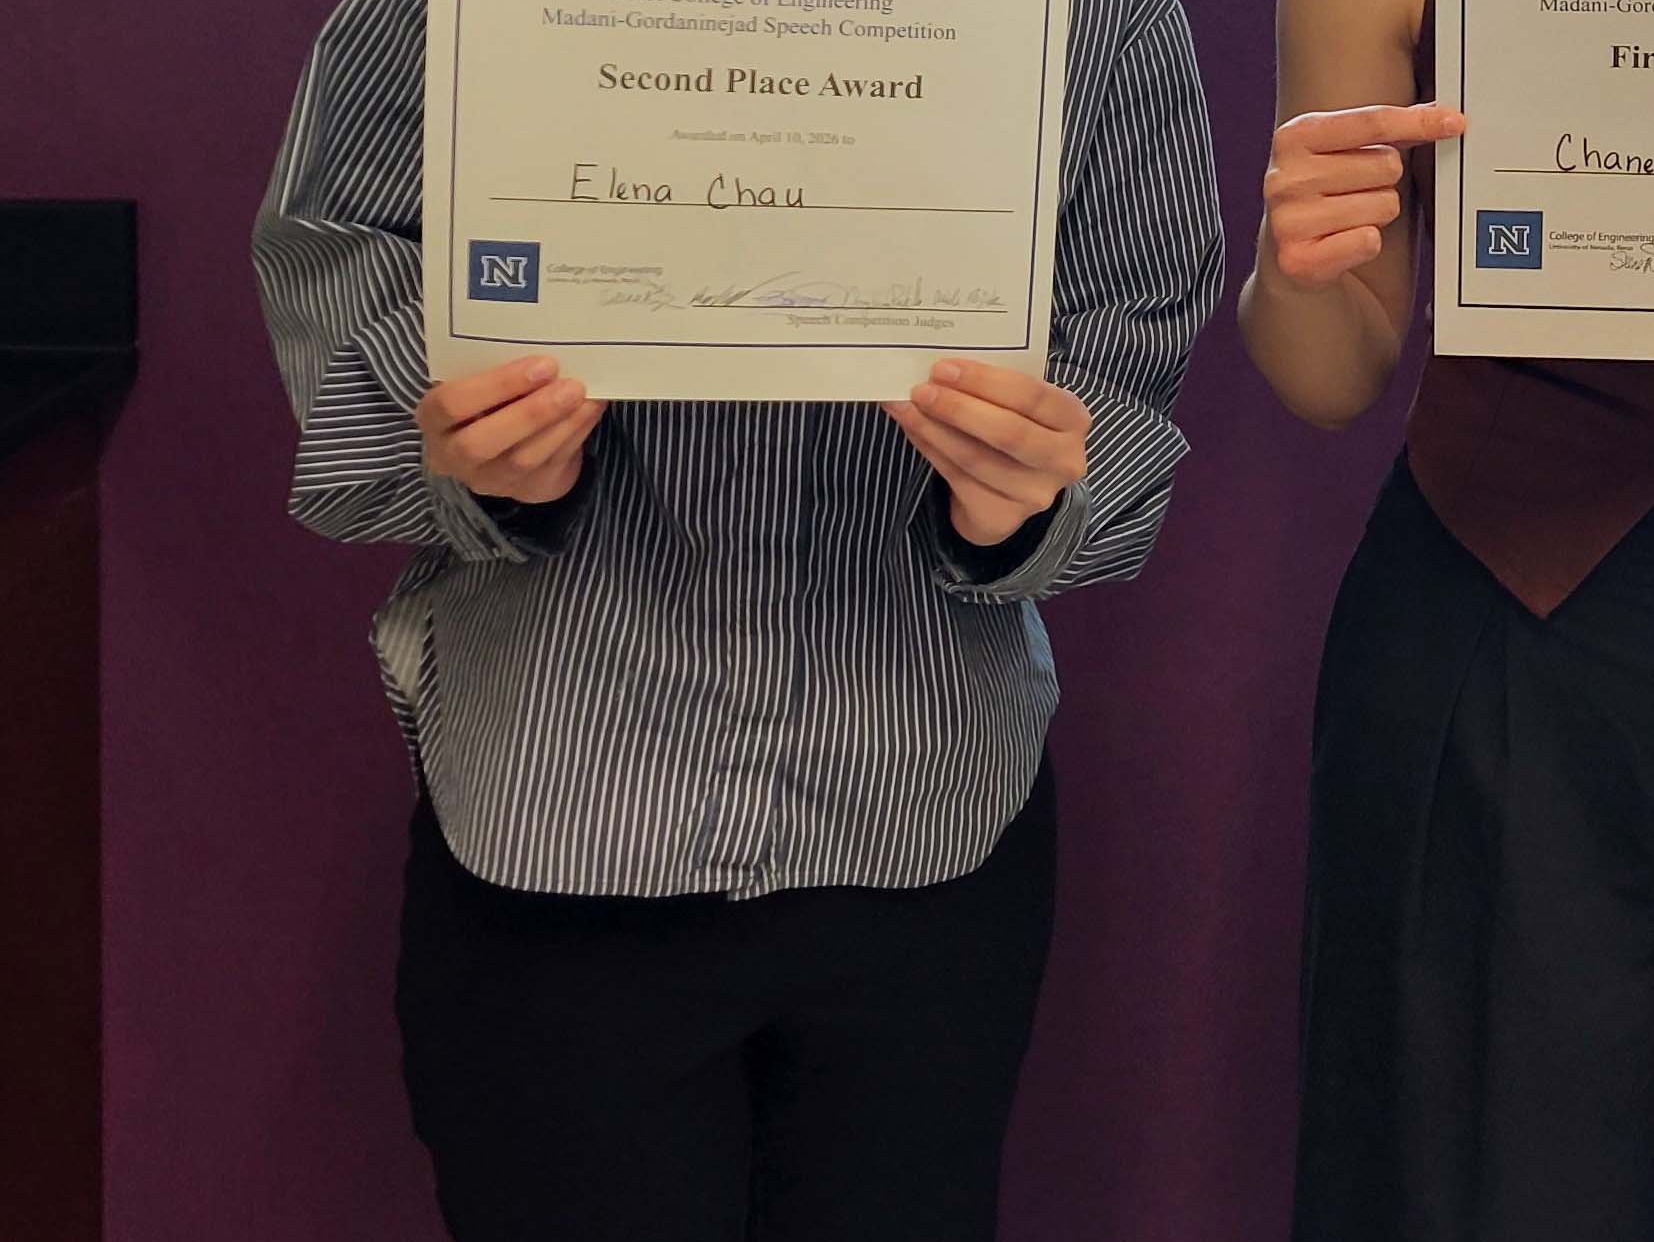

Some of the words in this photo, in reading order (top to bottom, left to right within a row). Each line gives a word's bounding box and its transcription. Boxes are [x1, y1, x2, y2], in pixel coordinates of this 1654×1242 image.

[541, 7, 758, 37] Madani-Gordaninejad
[764, 14, 833, 38] Speech
[839, 17, 957, 42] Competition
[597, 63, 715, 94] Second
[726, 66, 811, 97] Place
[819, 70, 924, 100] Award
[570, 160, 673, 203] Elena
[706, 171, 807, 210] Chau
[1488, 224, 1530, 255] N
[1549, 230, 1584, 244] College
[1586, 230, 1597, 242] of
[1598, 230, 1654, 246] Engineering
[479, 255, 527, 287] N
